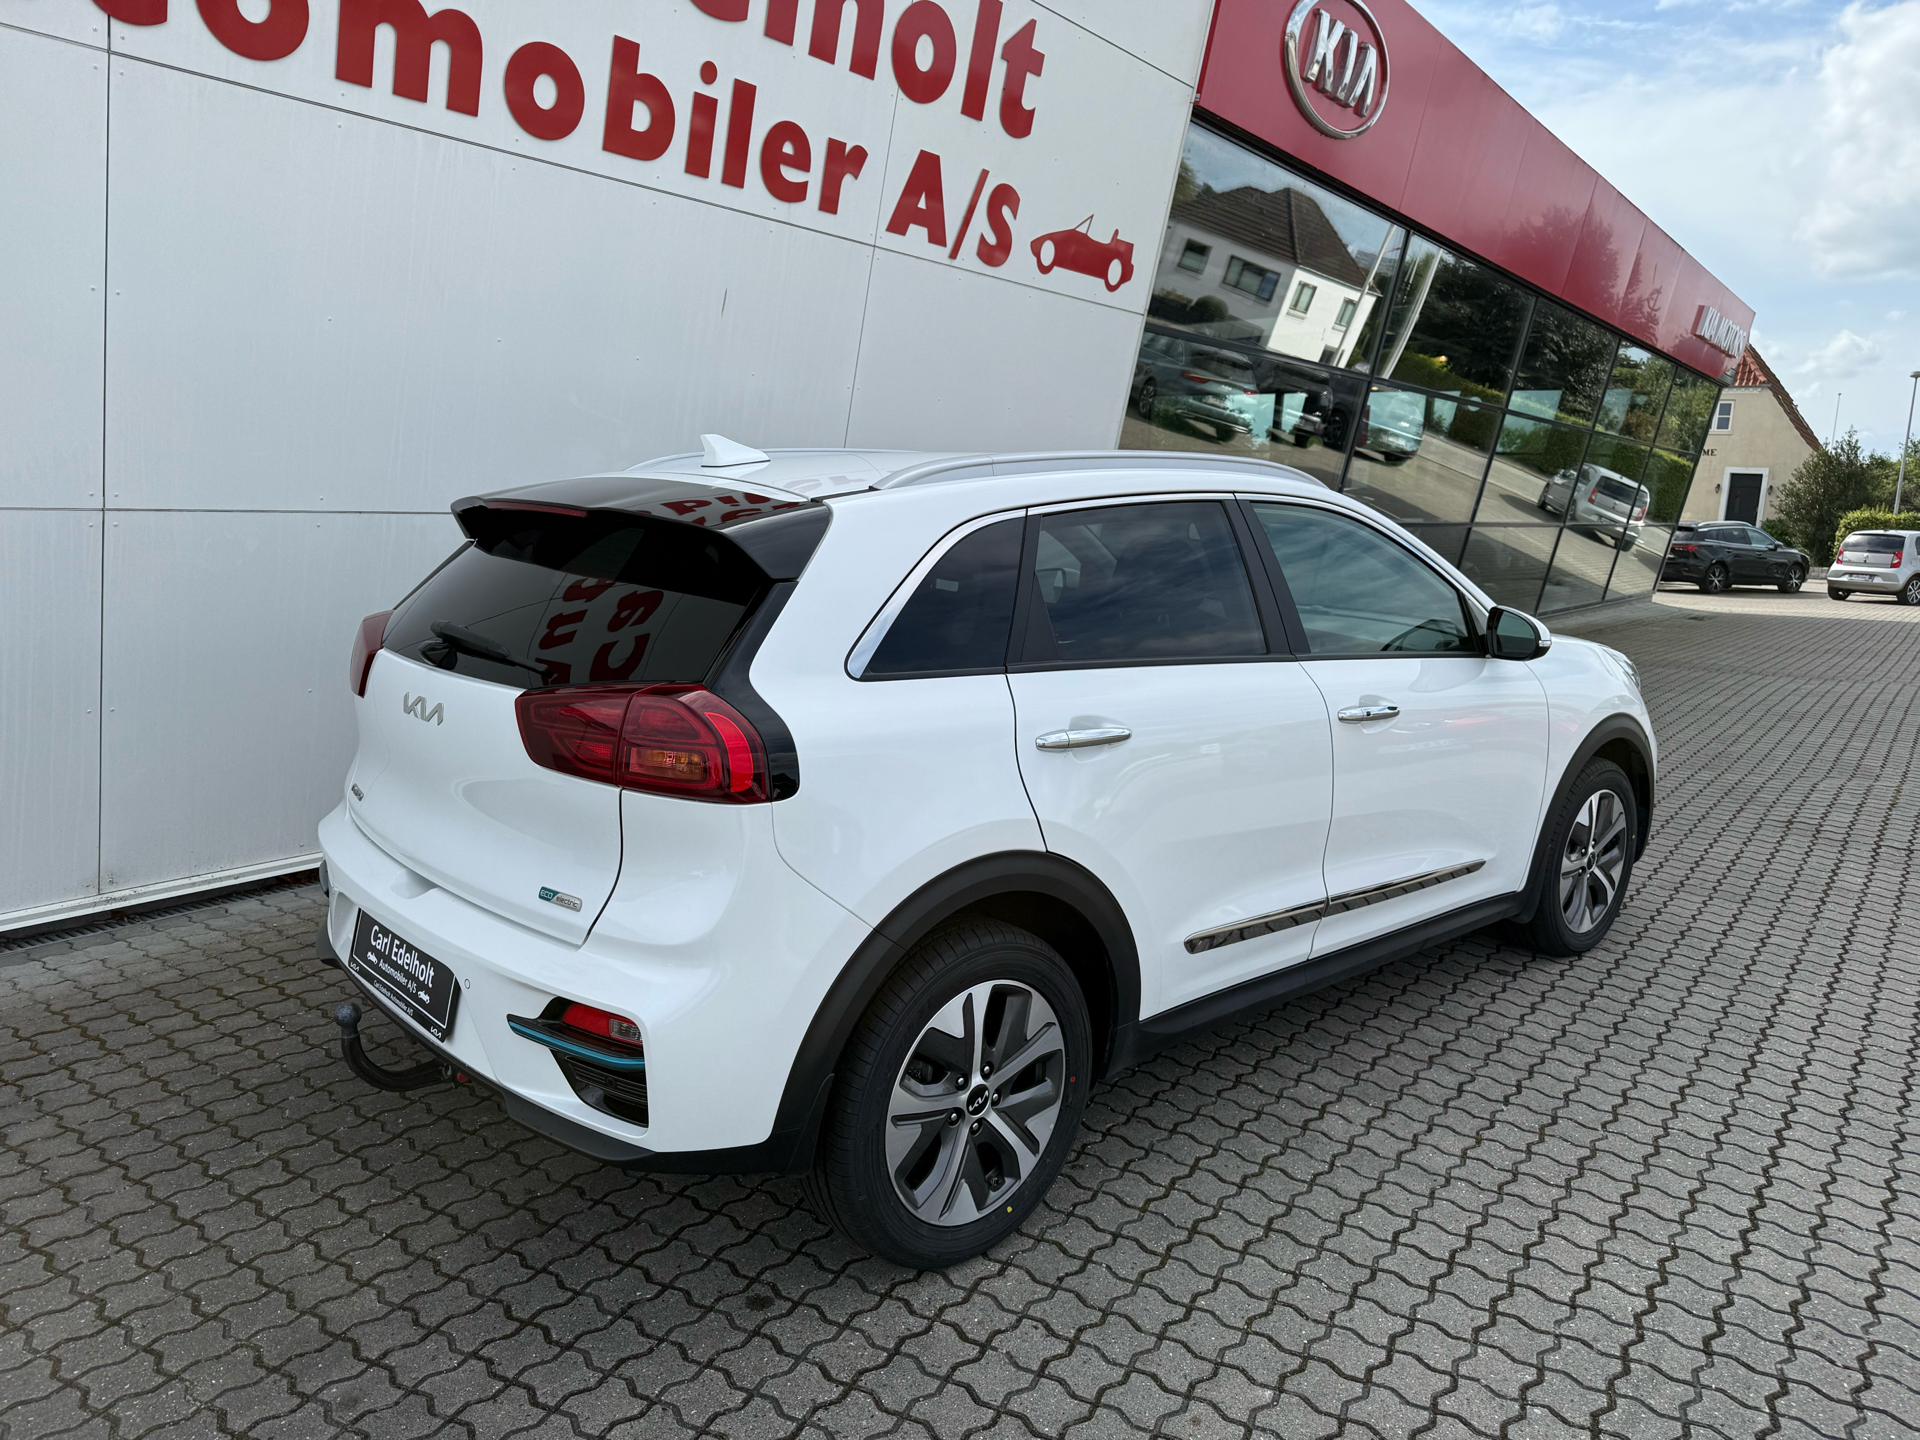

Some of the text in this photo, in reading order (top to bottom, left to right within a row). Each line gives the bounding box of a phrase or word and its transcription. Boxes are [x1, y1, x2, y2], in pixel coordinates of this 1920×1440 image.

[1303, 8, 1377, 118] KIA
[886, 149, 1020, 267] A/S
[1701, 306, 1720, 344] KIA
[555, 895, 579, 909] electric
[370, 925, 434, 988] Carl Edelholt
[378, 958, 417, 994] Automobiler A/S
